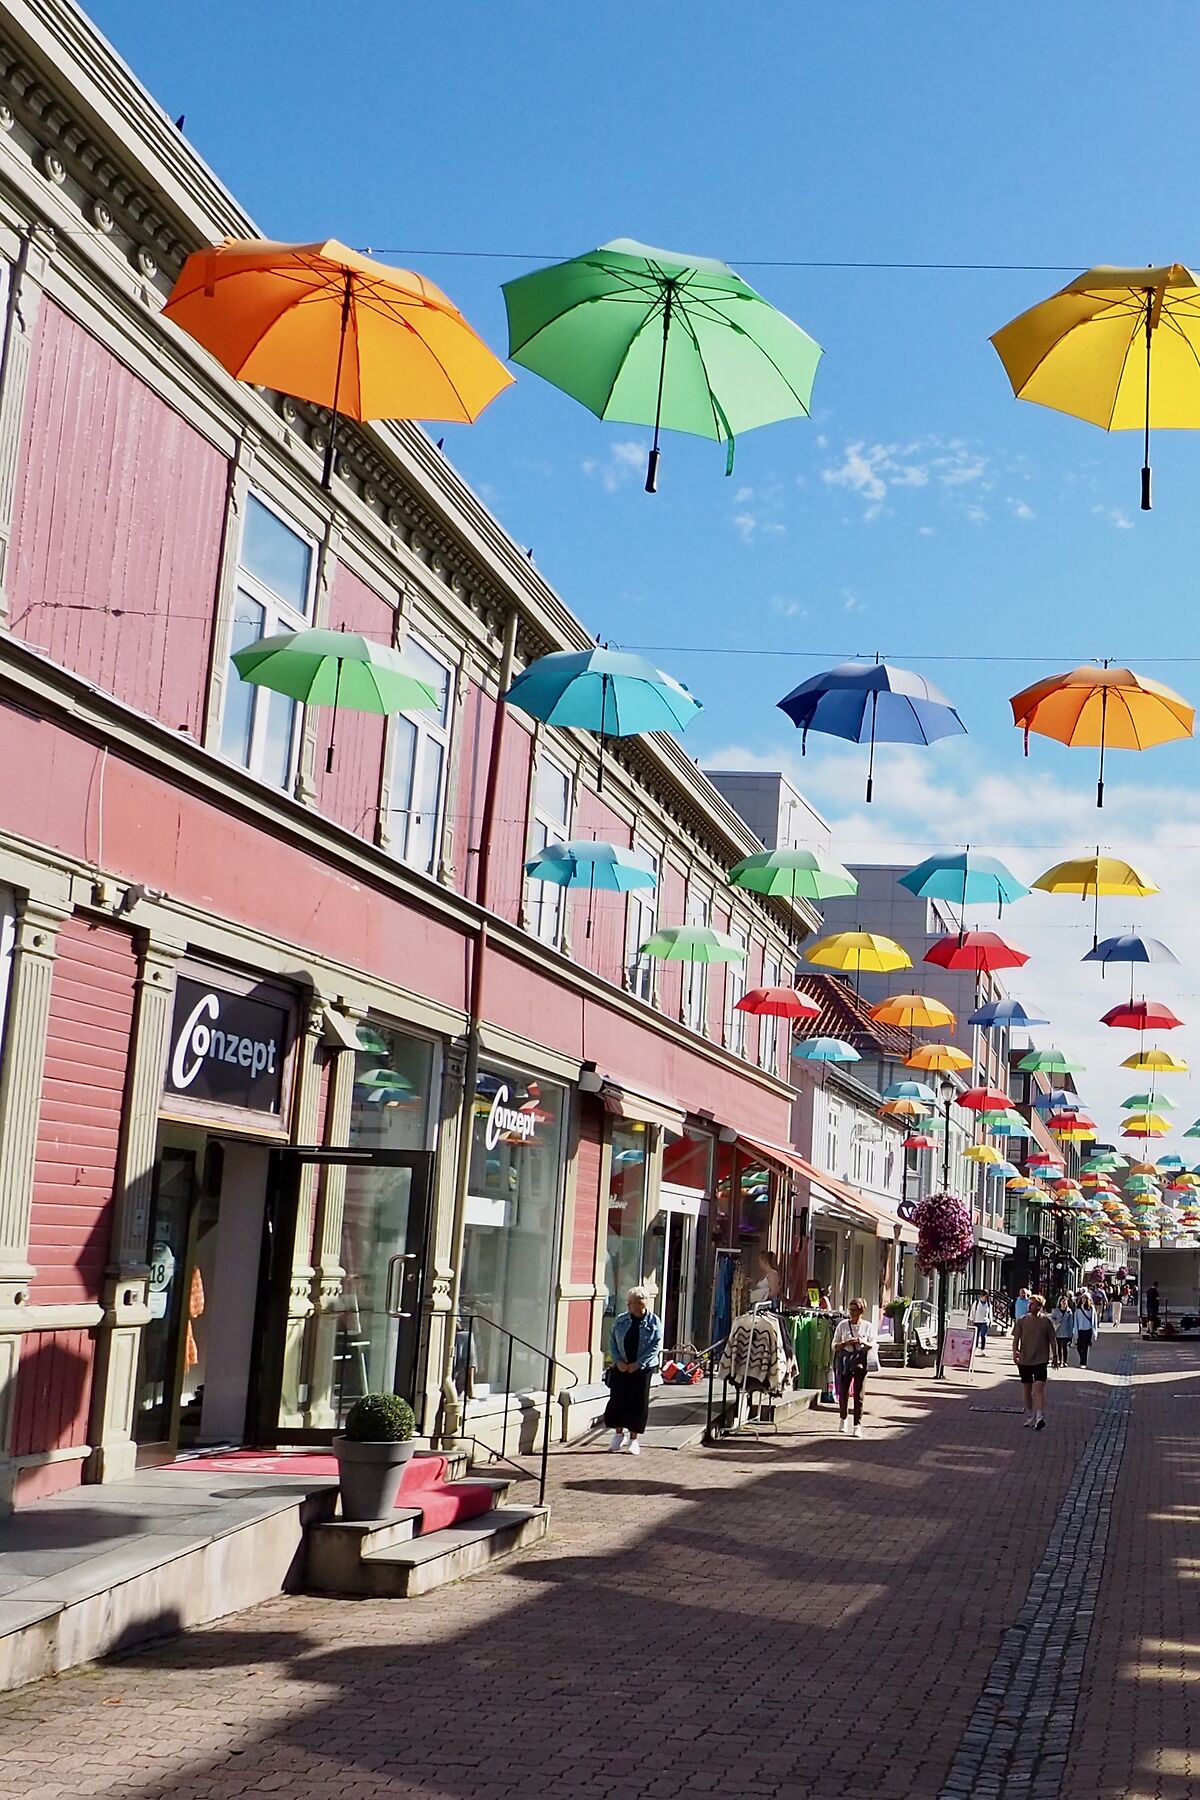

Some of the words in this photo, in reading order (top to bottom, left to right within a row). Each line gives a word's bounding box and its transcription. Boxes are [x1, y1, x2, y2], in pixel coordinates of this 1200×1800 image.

[172, 994, 276, 1089] Conzept
[486, 1085, 535, 1151] Conzept
[150, 1264, 165, 1283] 18
